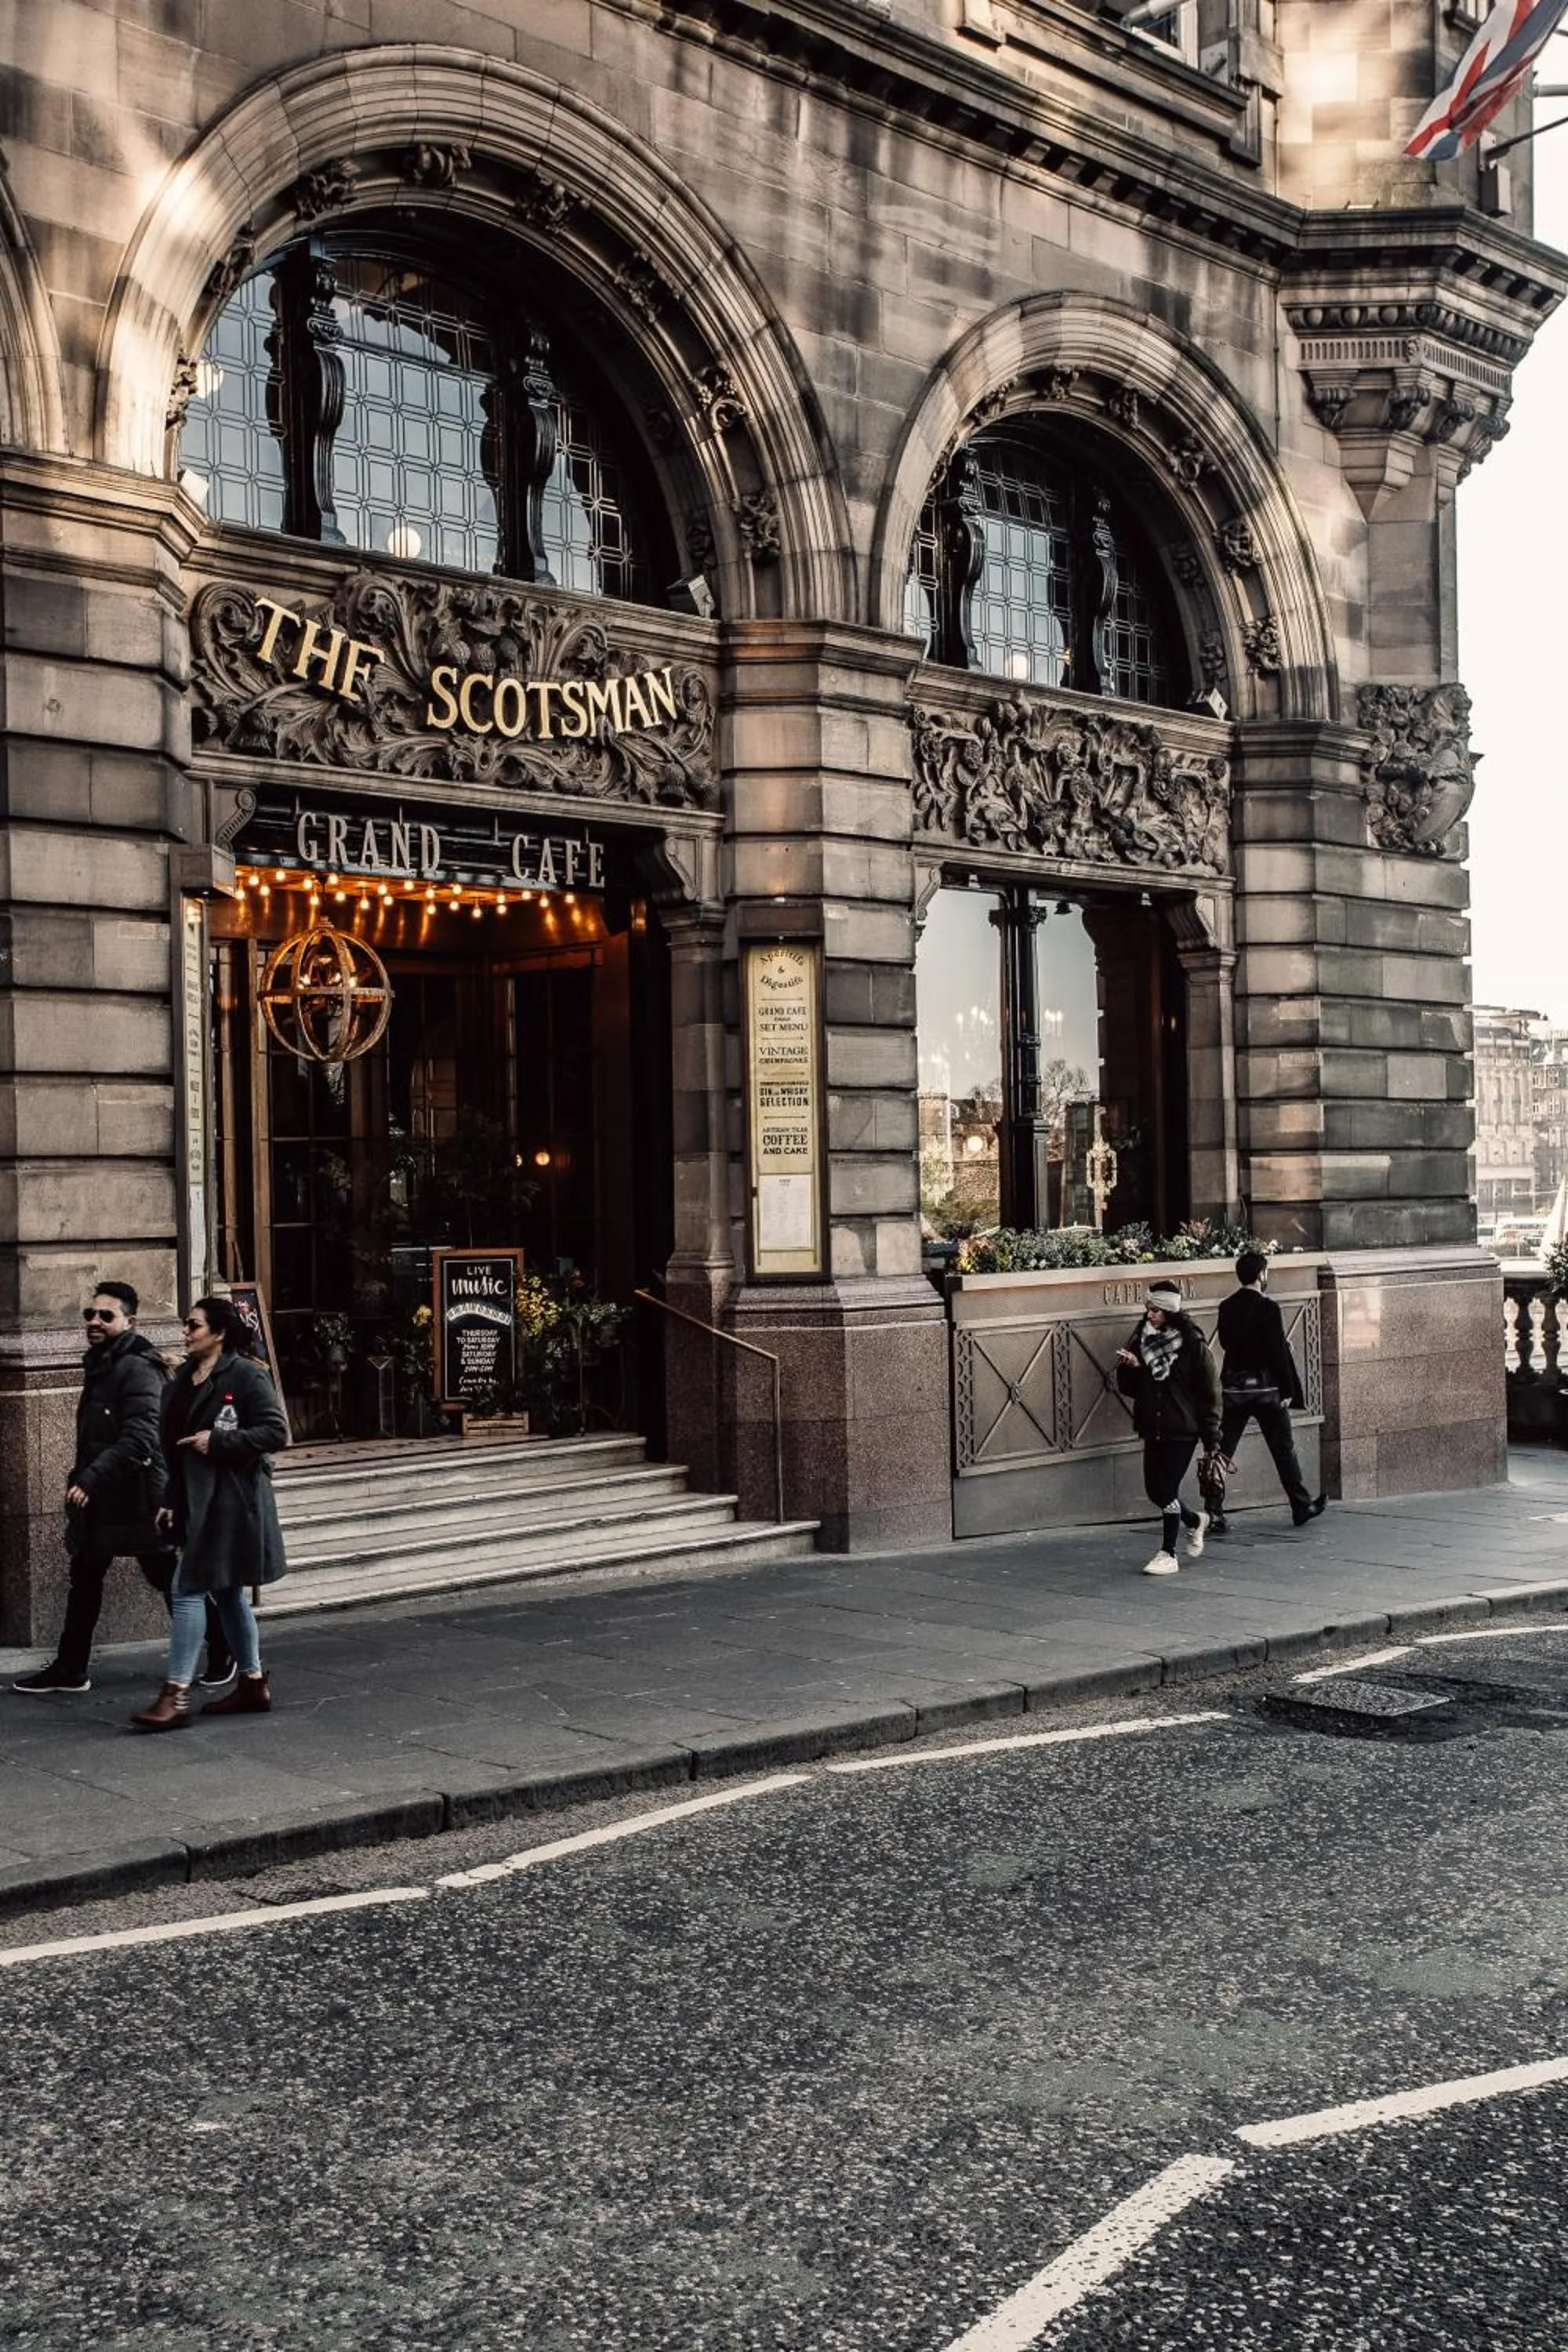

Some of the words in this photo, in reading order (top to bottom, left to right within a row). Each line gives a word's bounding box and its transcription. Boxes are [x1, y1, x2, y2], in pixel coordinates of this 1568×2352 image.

[255, 597, 385, 702] THE
[426, 665, 678, 739] SCOTSMAN
[297, 811, 441, 872] GRAND
[512, 833, 605, 888] CAFE
[777, 965, 785, 974] &
[758, 1007, 785, 1016] GRAND
[759, 1023, 778, 1032] SET
[779, 1022, 808, 1032] MENU
[759, 1047, 808, 1056] VINTAGE
[760, 1097, 810, 1108] SELECTION
[762, 1134, 808, 1146] COFFEE
[466, 1265, 492, 1276] LIVE
[462, 1329, 499, 1338] THURSDAY
[466, 1357, 496, 1366] SUNDAY
